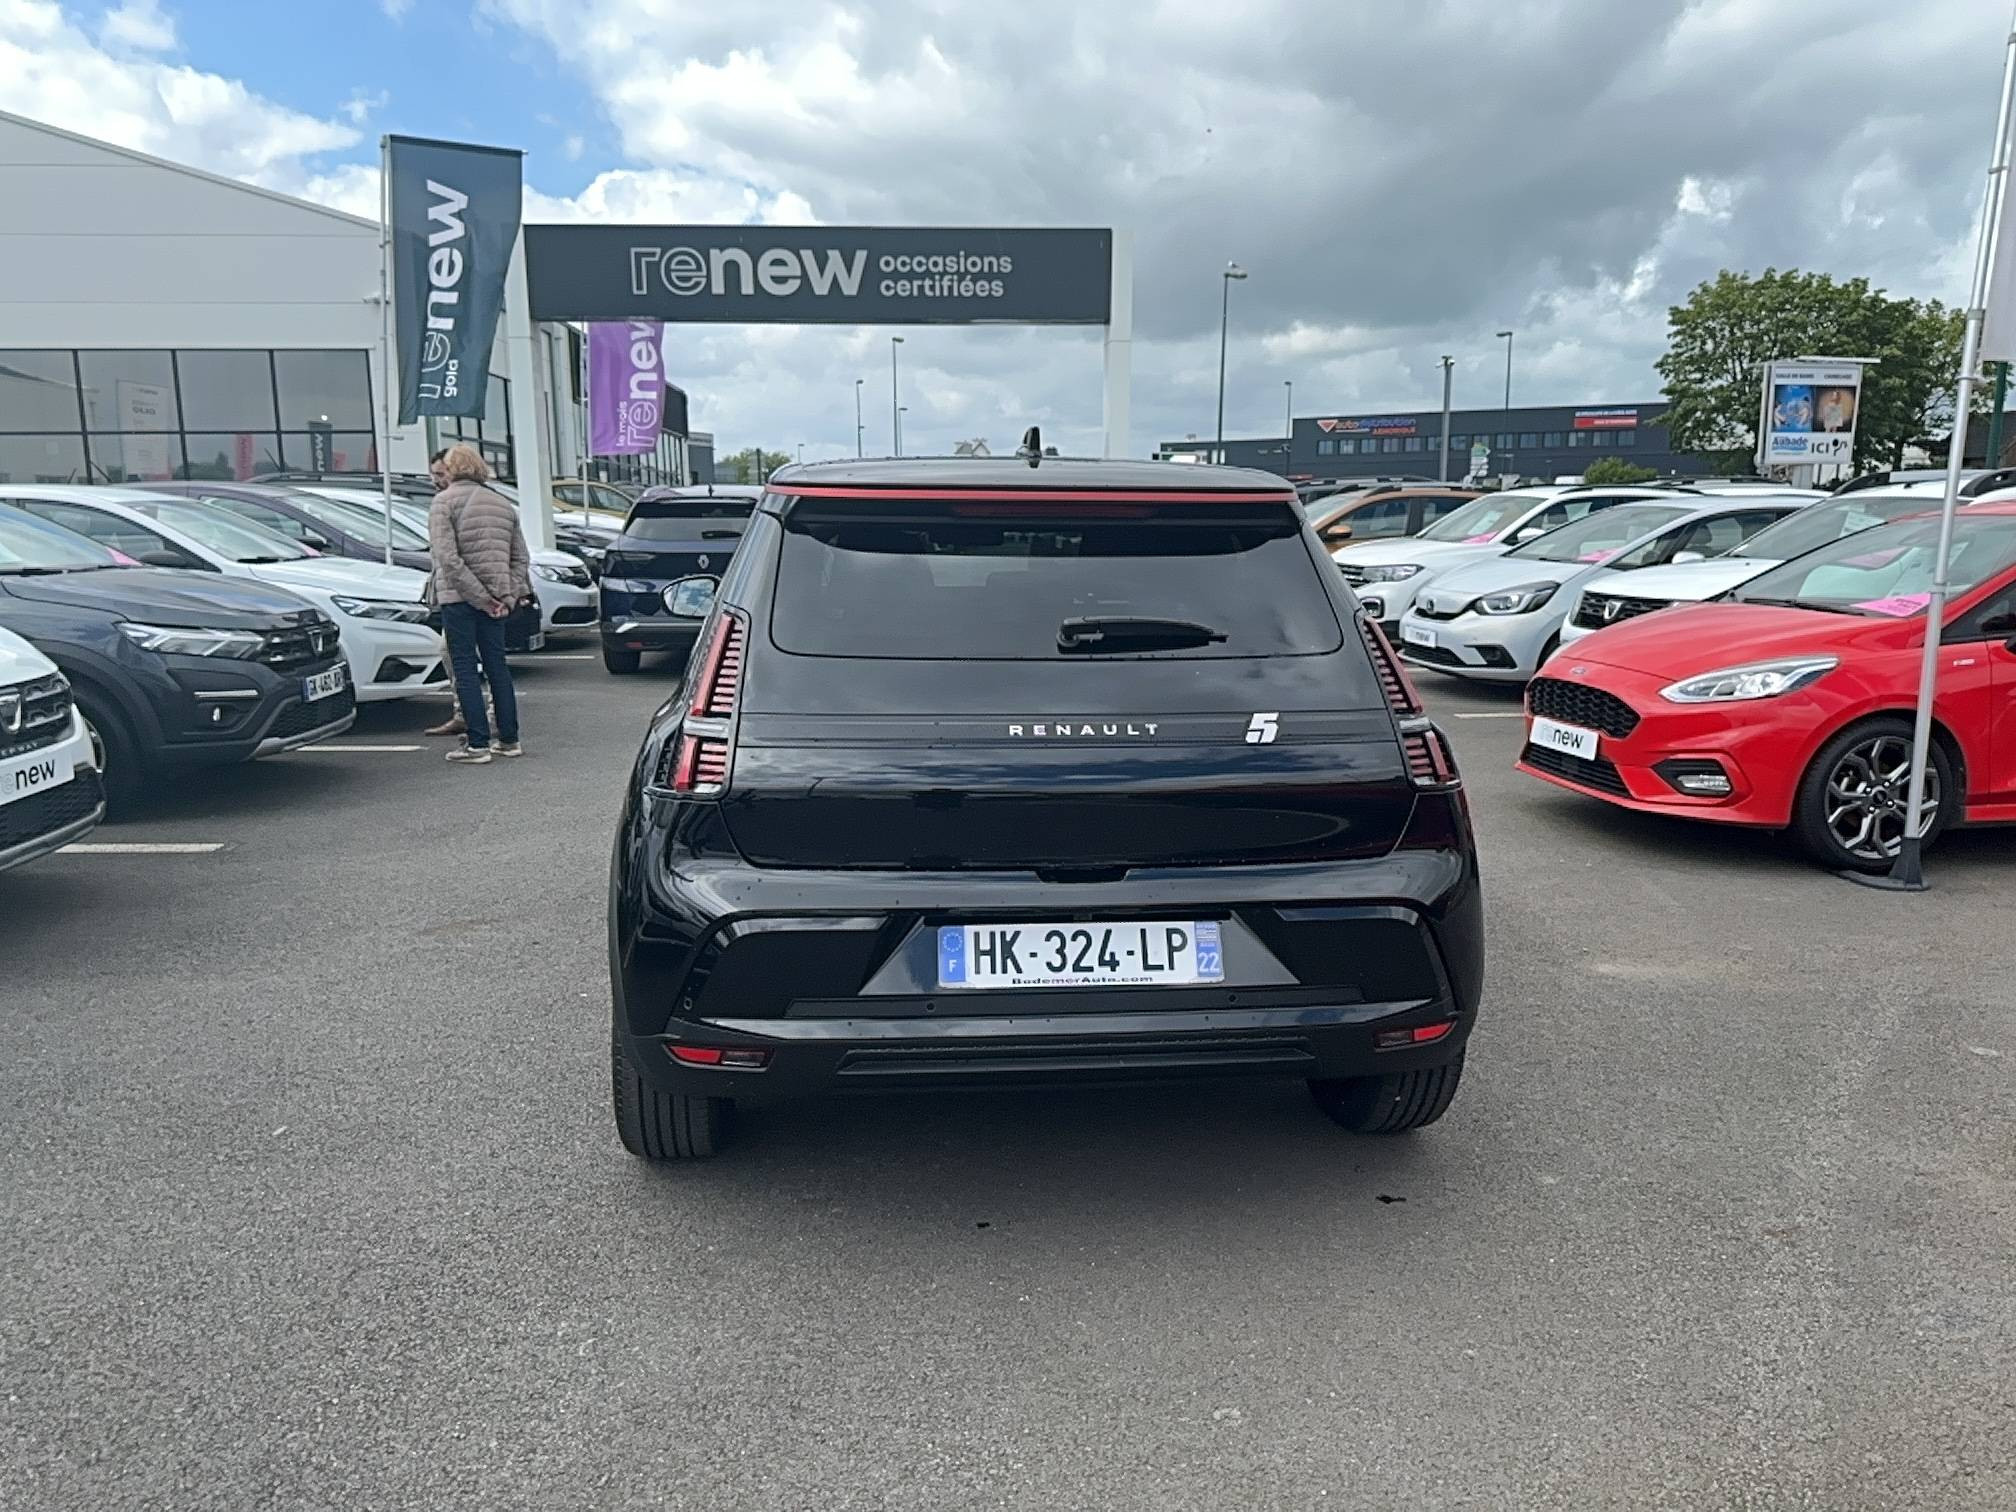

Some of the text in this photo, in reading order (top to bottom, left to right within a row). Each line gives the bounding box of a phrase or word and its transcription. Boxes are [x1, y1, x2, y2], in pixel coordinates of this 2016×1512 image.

[631, 247, 867, 296] renew
[879, 251, 1013, 274] occasions
[418, 179, 468, 399] renew
[879, 275, 1004, 297] certifiées
[1811, 443, 1829, 454] ICI
[1008, 722, 1159, 737] RENAULT
[973, 928, 1188, 975] HK-324-LP
[1198, 952, 1220, 972] 22
[949, 959, 957, 972] F
